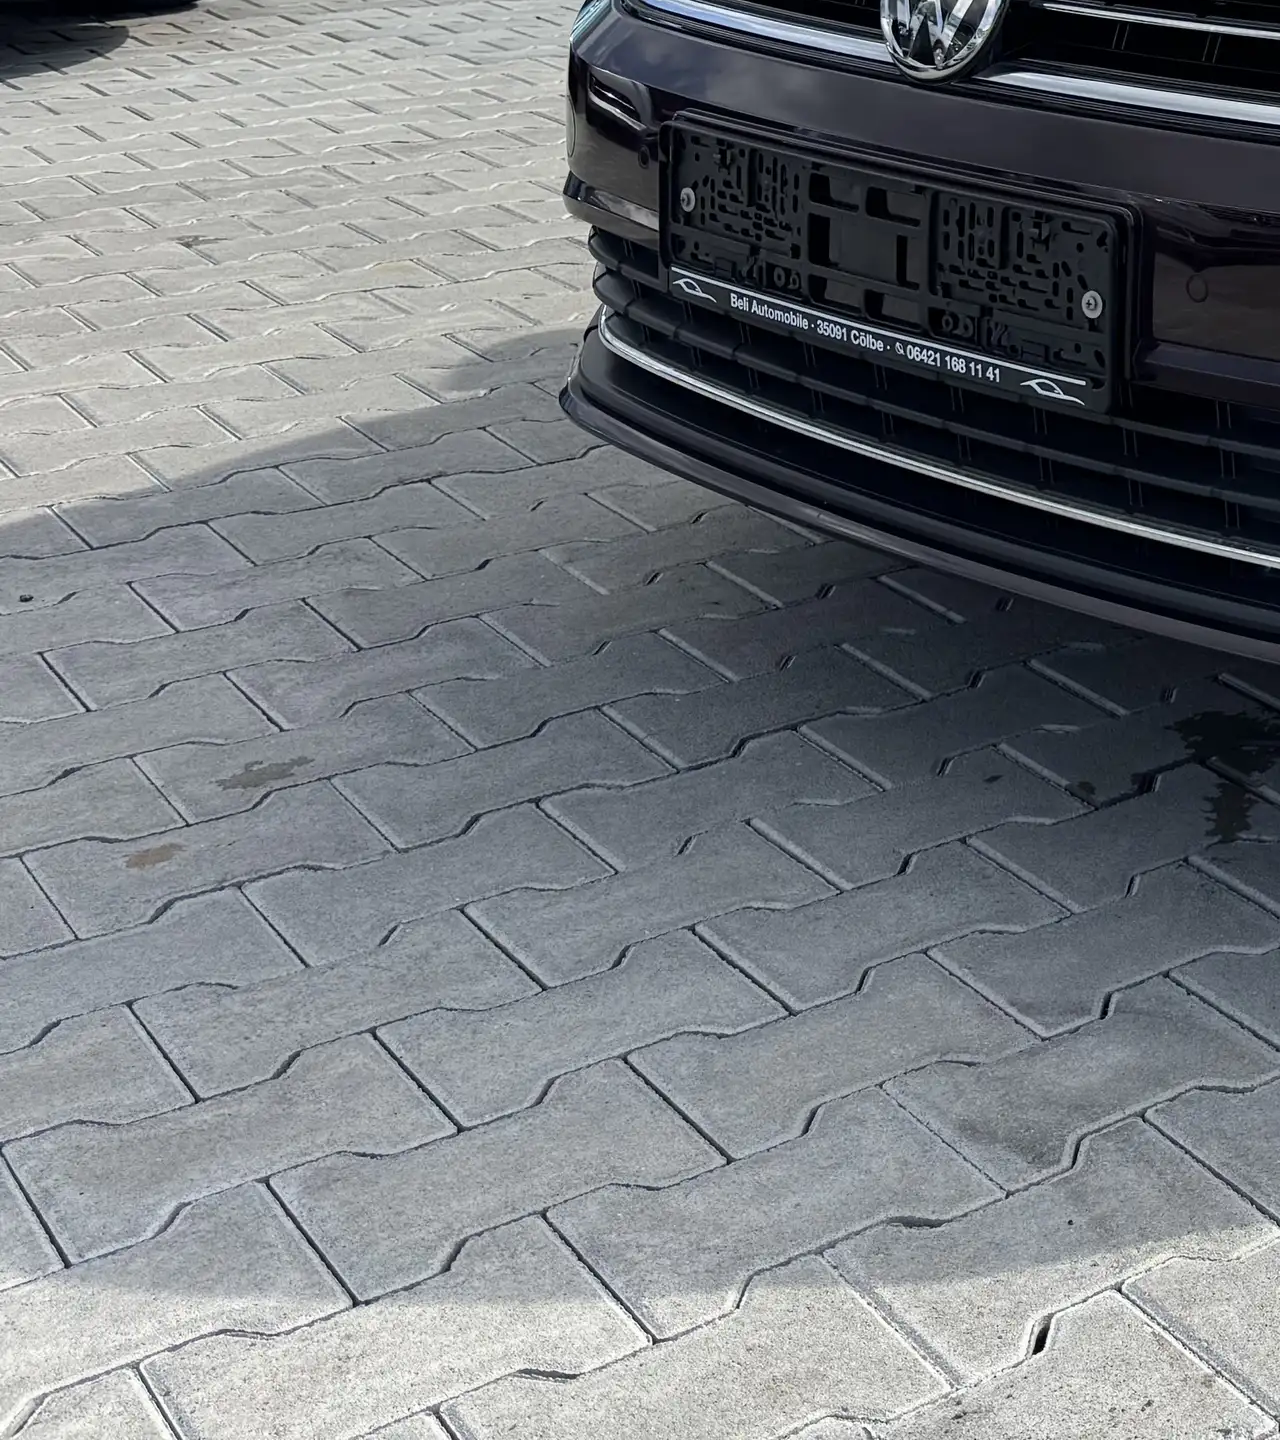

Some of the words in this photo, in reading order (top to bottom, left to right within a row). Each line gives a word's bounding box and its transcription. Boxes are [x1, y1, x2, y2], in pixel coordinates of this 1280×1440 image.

[730, 292, 749, 311] Beli
[751, 299, 809, 330] Automobile
[816, 319, 848, 341] 35091
[850, 329, 884, 352] Cölbe
[906, 344, 941, 367] 06421
[945, 355, 967, 374] 168
[969, 361, 983, 378] 11
[986, 366, 1000, 383] 41
